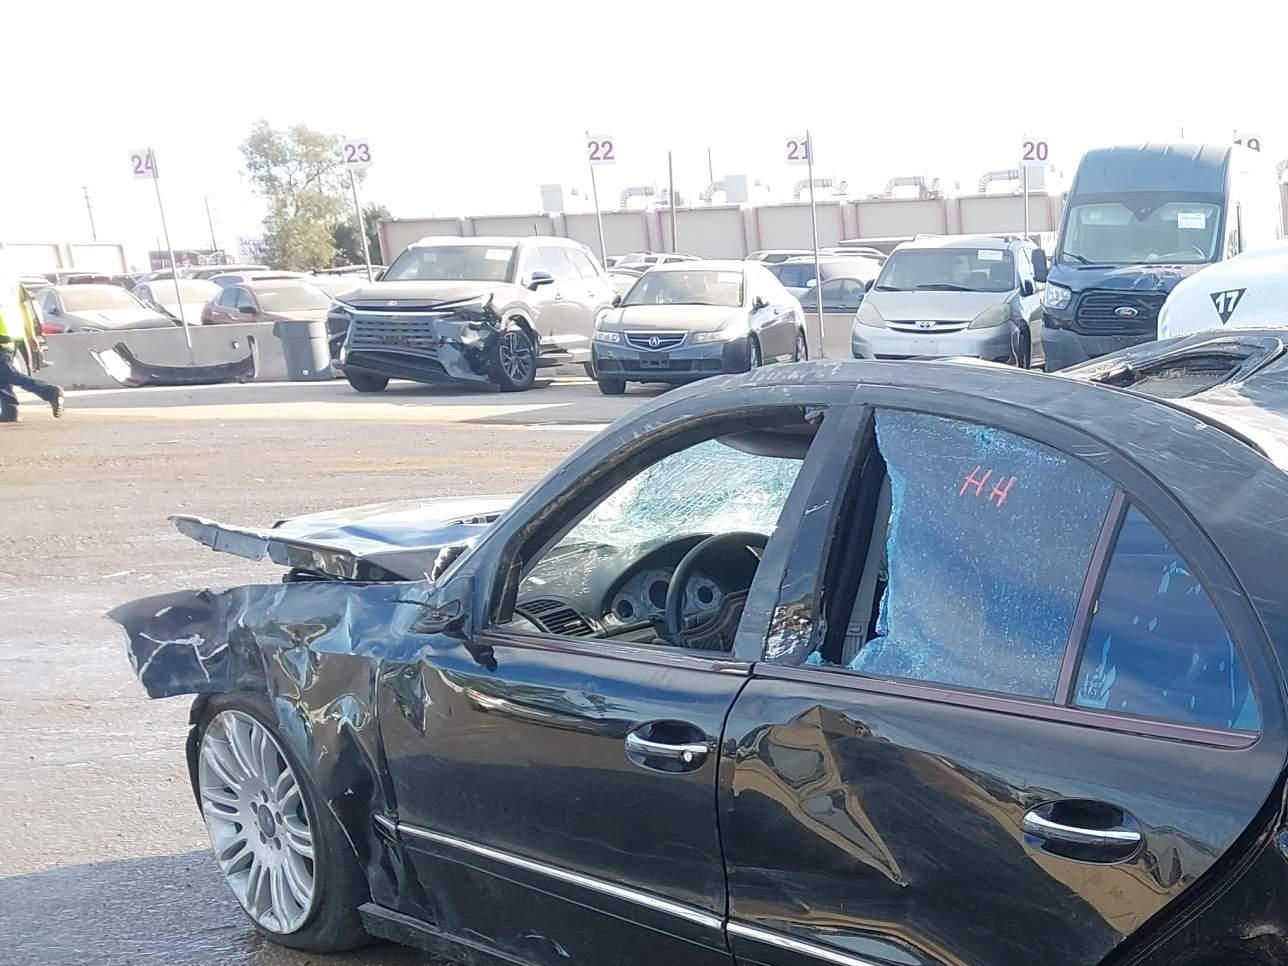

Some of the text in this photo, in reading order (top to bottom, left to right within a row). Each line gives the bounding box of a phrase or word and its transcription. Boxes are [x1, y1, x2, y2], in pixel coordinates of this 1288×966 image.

[343, 143, 372, 163] 23
[587, 140, 615, 161] 22
[786, 140, 811, 161] 21
[1022, 141, 1048, 161] 20
[1214, 290, 1240, 314] 17
